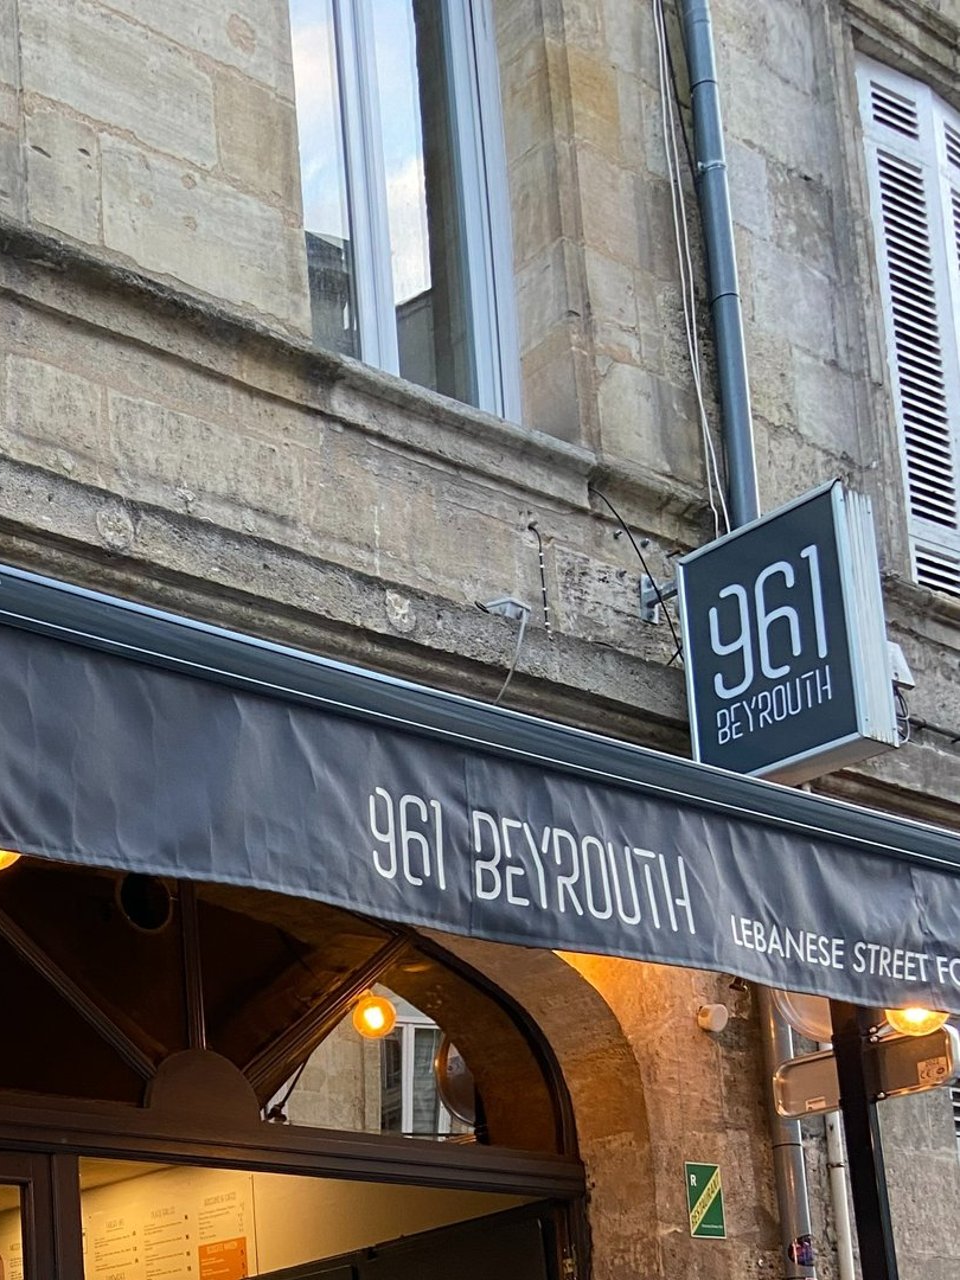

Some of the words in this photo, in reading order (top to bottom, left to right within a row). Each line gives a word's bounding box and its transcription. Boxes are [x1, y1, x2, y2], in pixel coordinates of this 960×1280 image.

[709, 544, 828, 699] 961
[717, 665, 832, 744] BEYROUTH
[369, 786, 446, 891] 961
[472, 810, 696, 934] BEYROUTH
[731, 914, 844, 969] LEBANESE
[852, 941, 929, 983] STREET
[936, 955, 960, 987] FO
[690, 1174, 697, 1186] R
